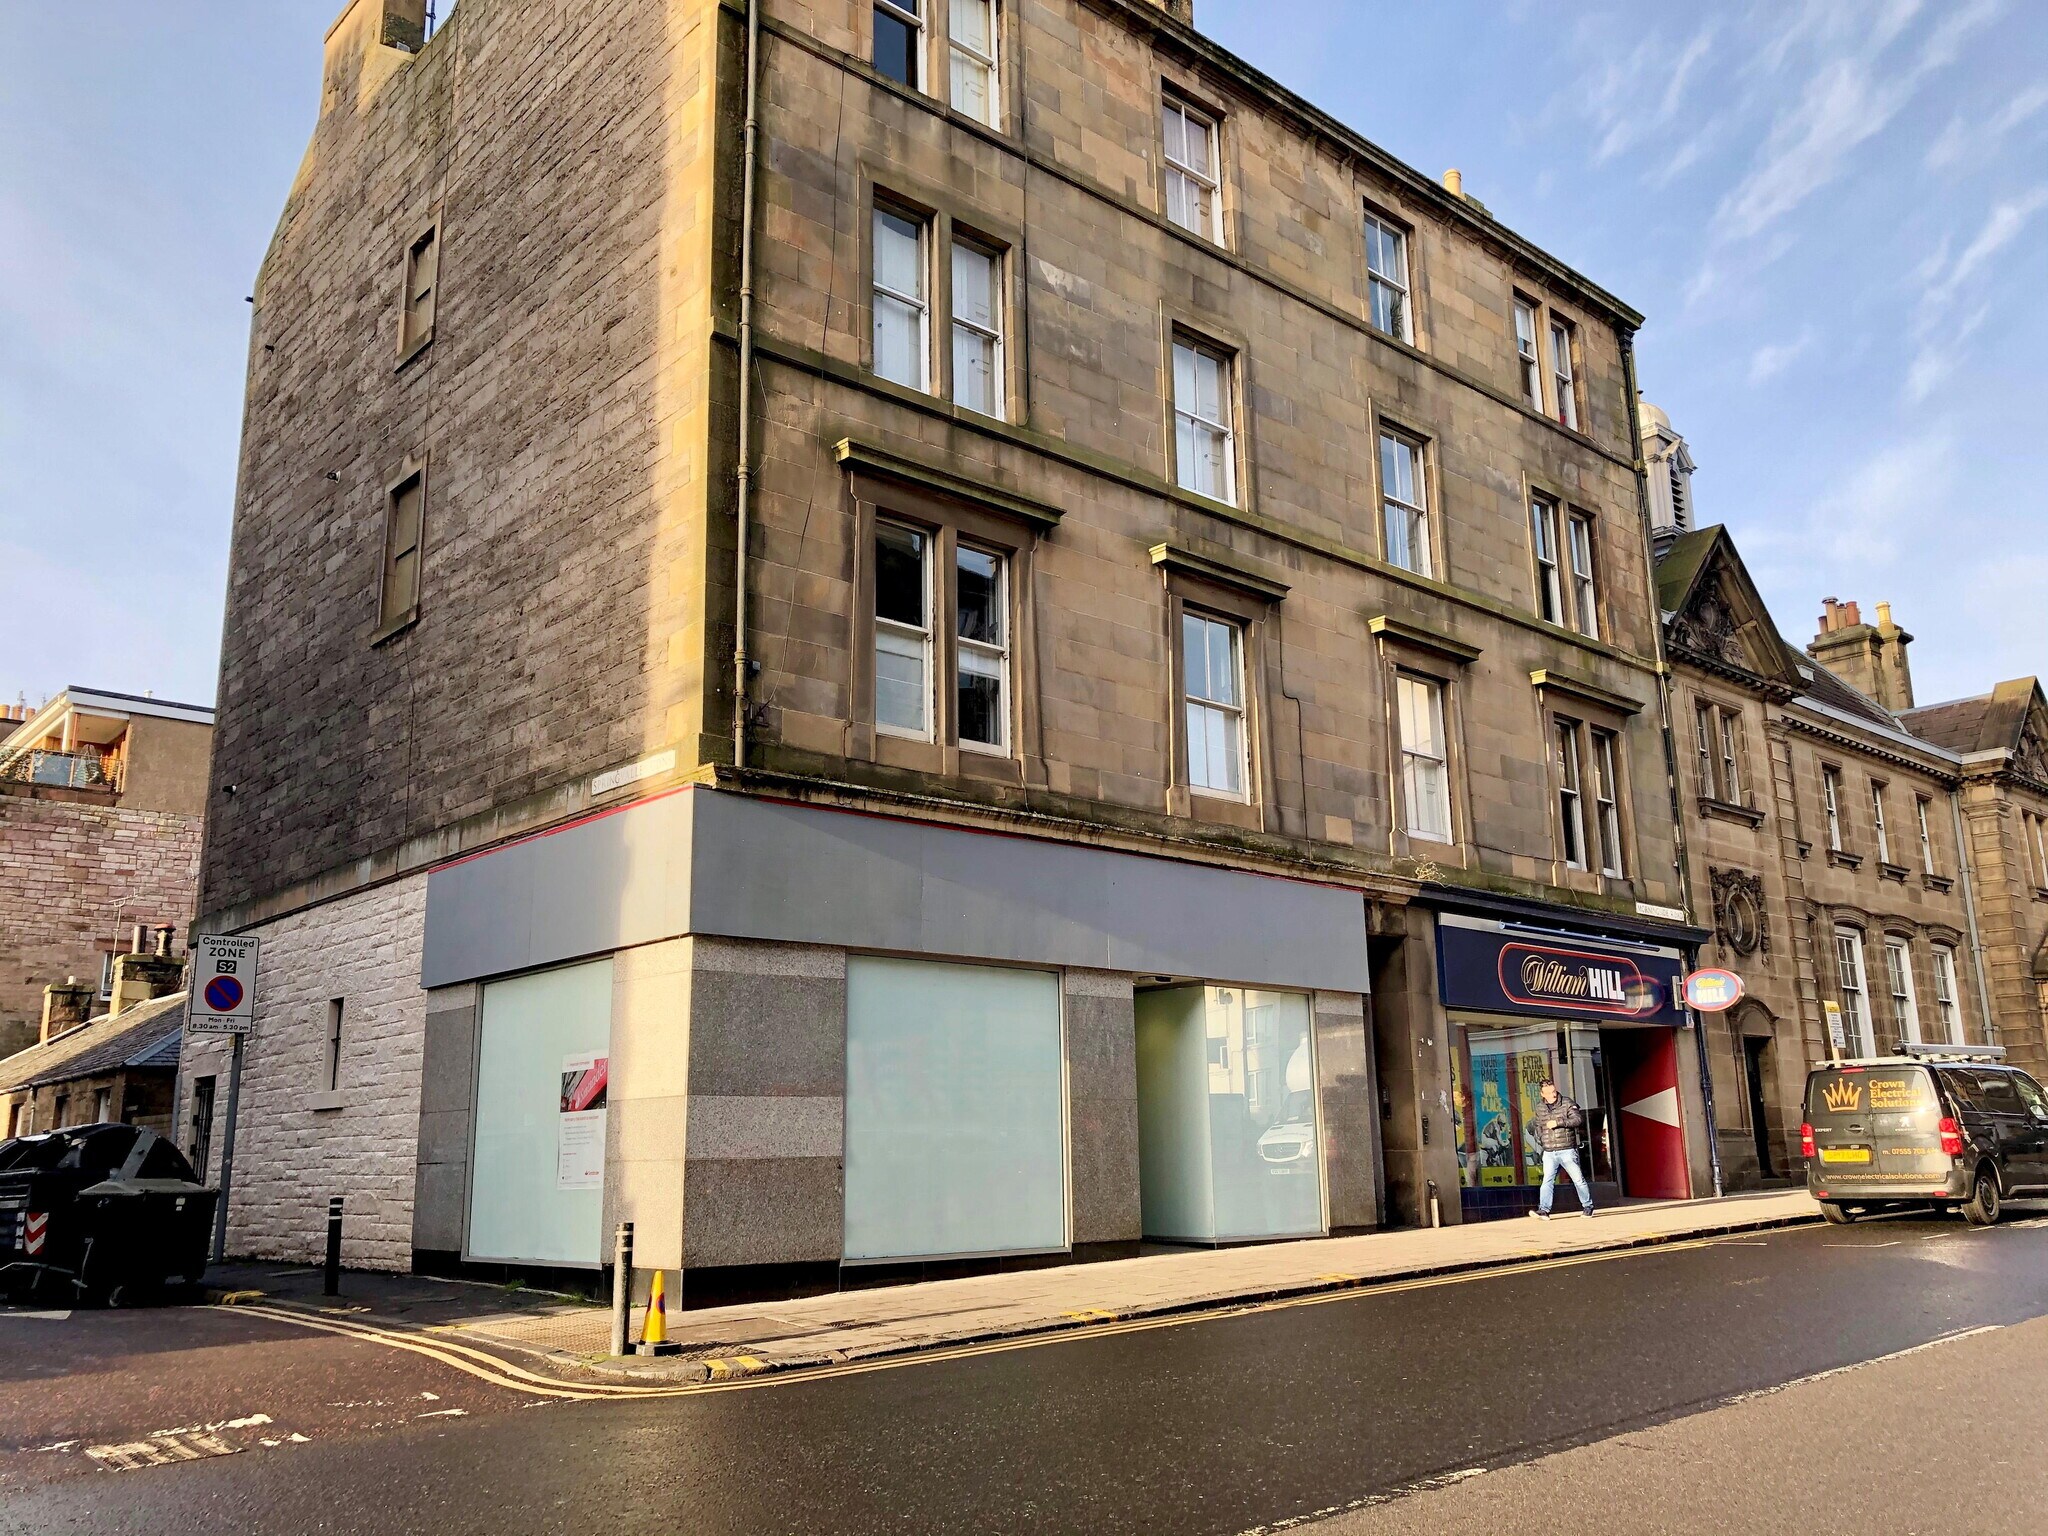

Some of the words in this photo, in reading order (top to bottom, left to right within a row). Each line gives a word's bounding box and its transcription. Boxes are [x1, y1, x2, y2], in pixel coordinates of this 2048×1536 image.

[203, 937, 254, 947] Controlled
[209, 947, 246, 958] ZONE
[219, 962, 235, 972] S2
[1521, 954, 1589, 996] William
[1588, 968, 1625, 1000] HILL
[1523, 1056, 1544, 1070] EXTRA
[1522, 1070, 1545, 1083] PLACES
[1869, 1080, 1905, 1088] Crown
[1870, 1087, 1921, 1098] Electrical
[1826, 1172, 1941, 1180] www.crownelectricalsolutions.com
